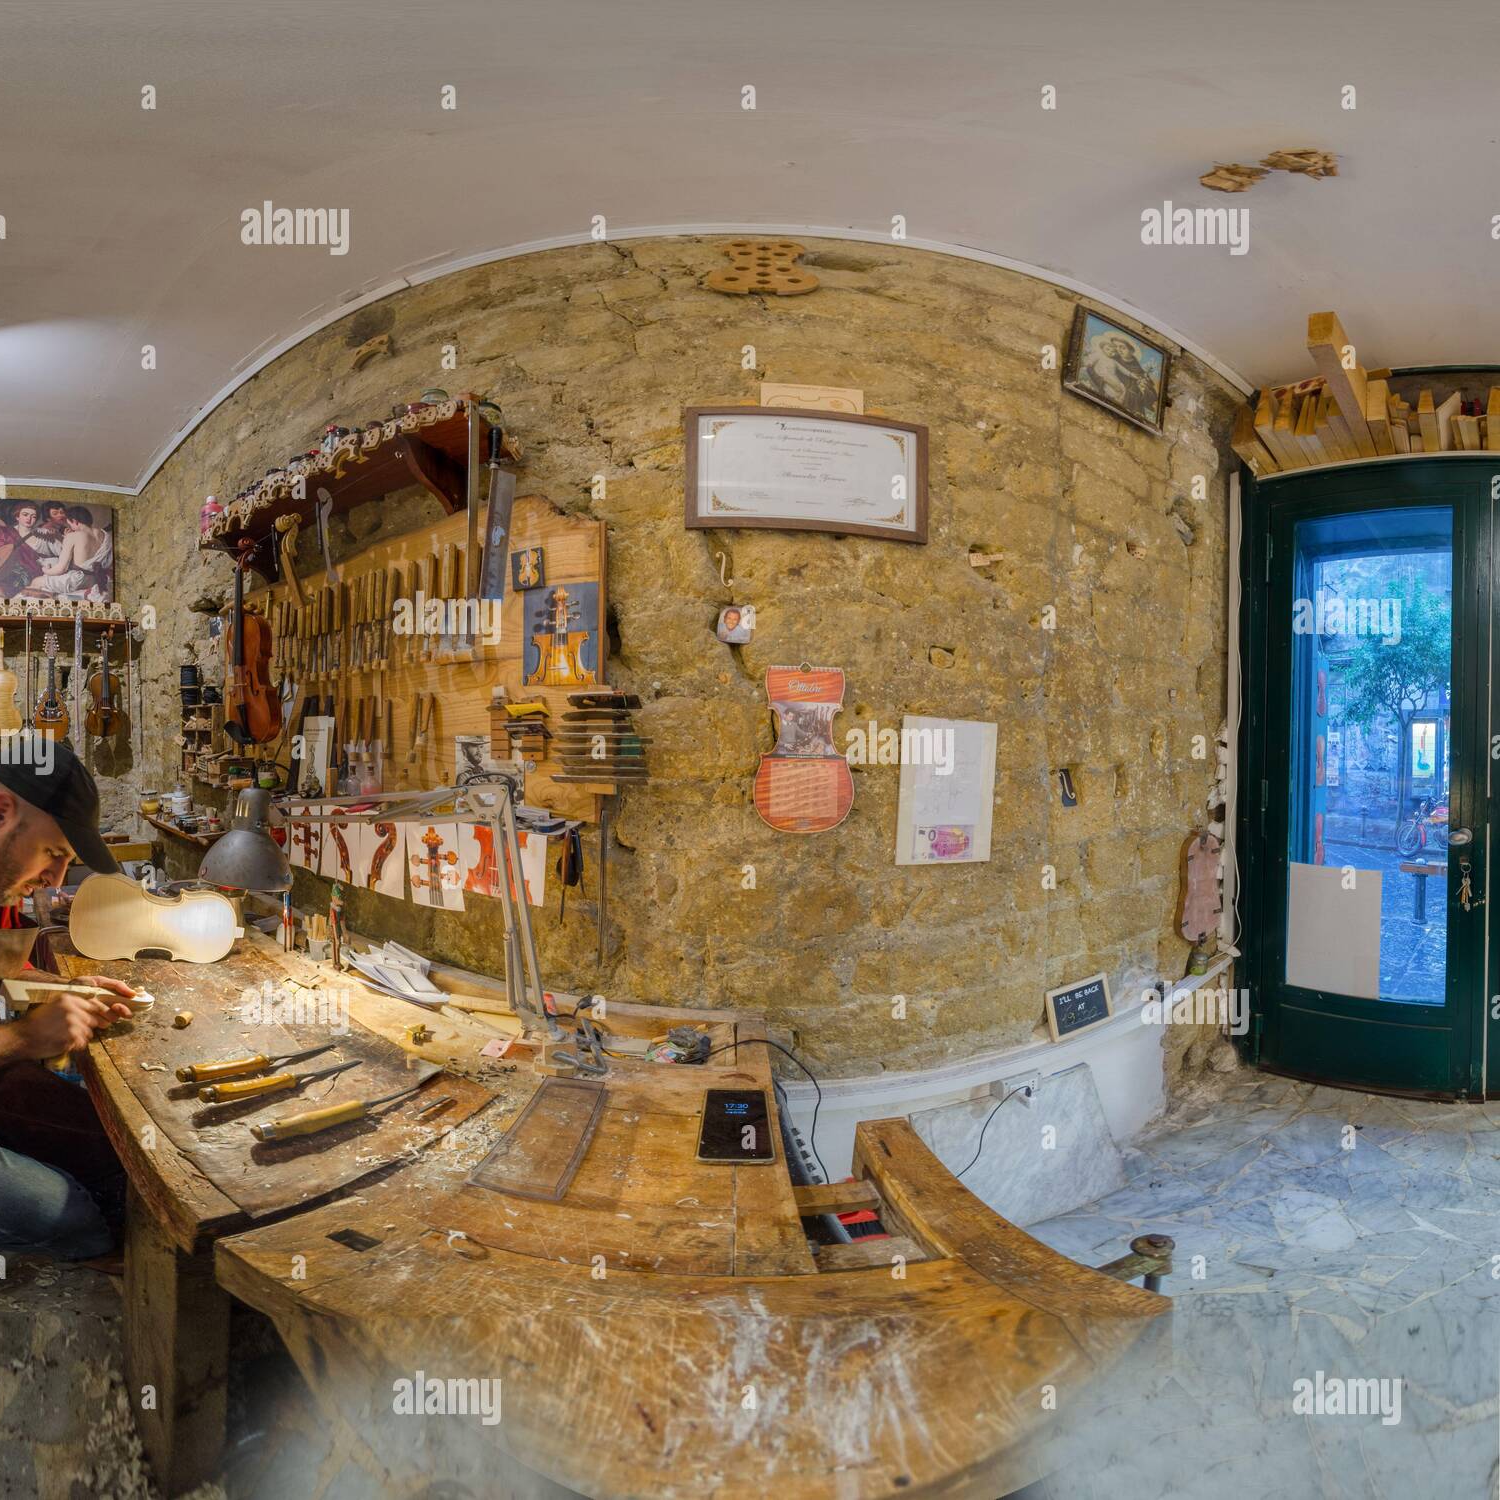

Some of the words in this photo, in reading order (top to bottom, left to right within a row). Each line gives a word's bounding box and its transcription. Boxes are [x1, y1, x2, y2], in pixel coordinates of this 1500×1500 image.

[1074, 991, 1083, 999] BE
[1084, 985, 1099, 995] BACK
[1077, 1002, 1085, 1011] AT
